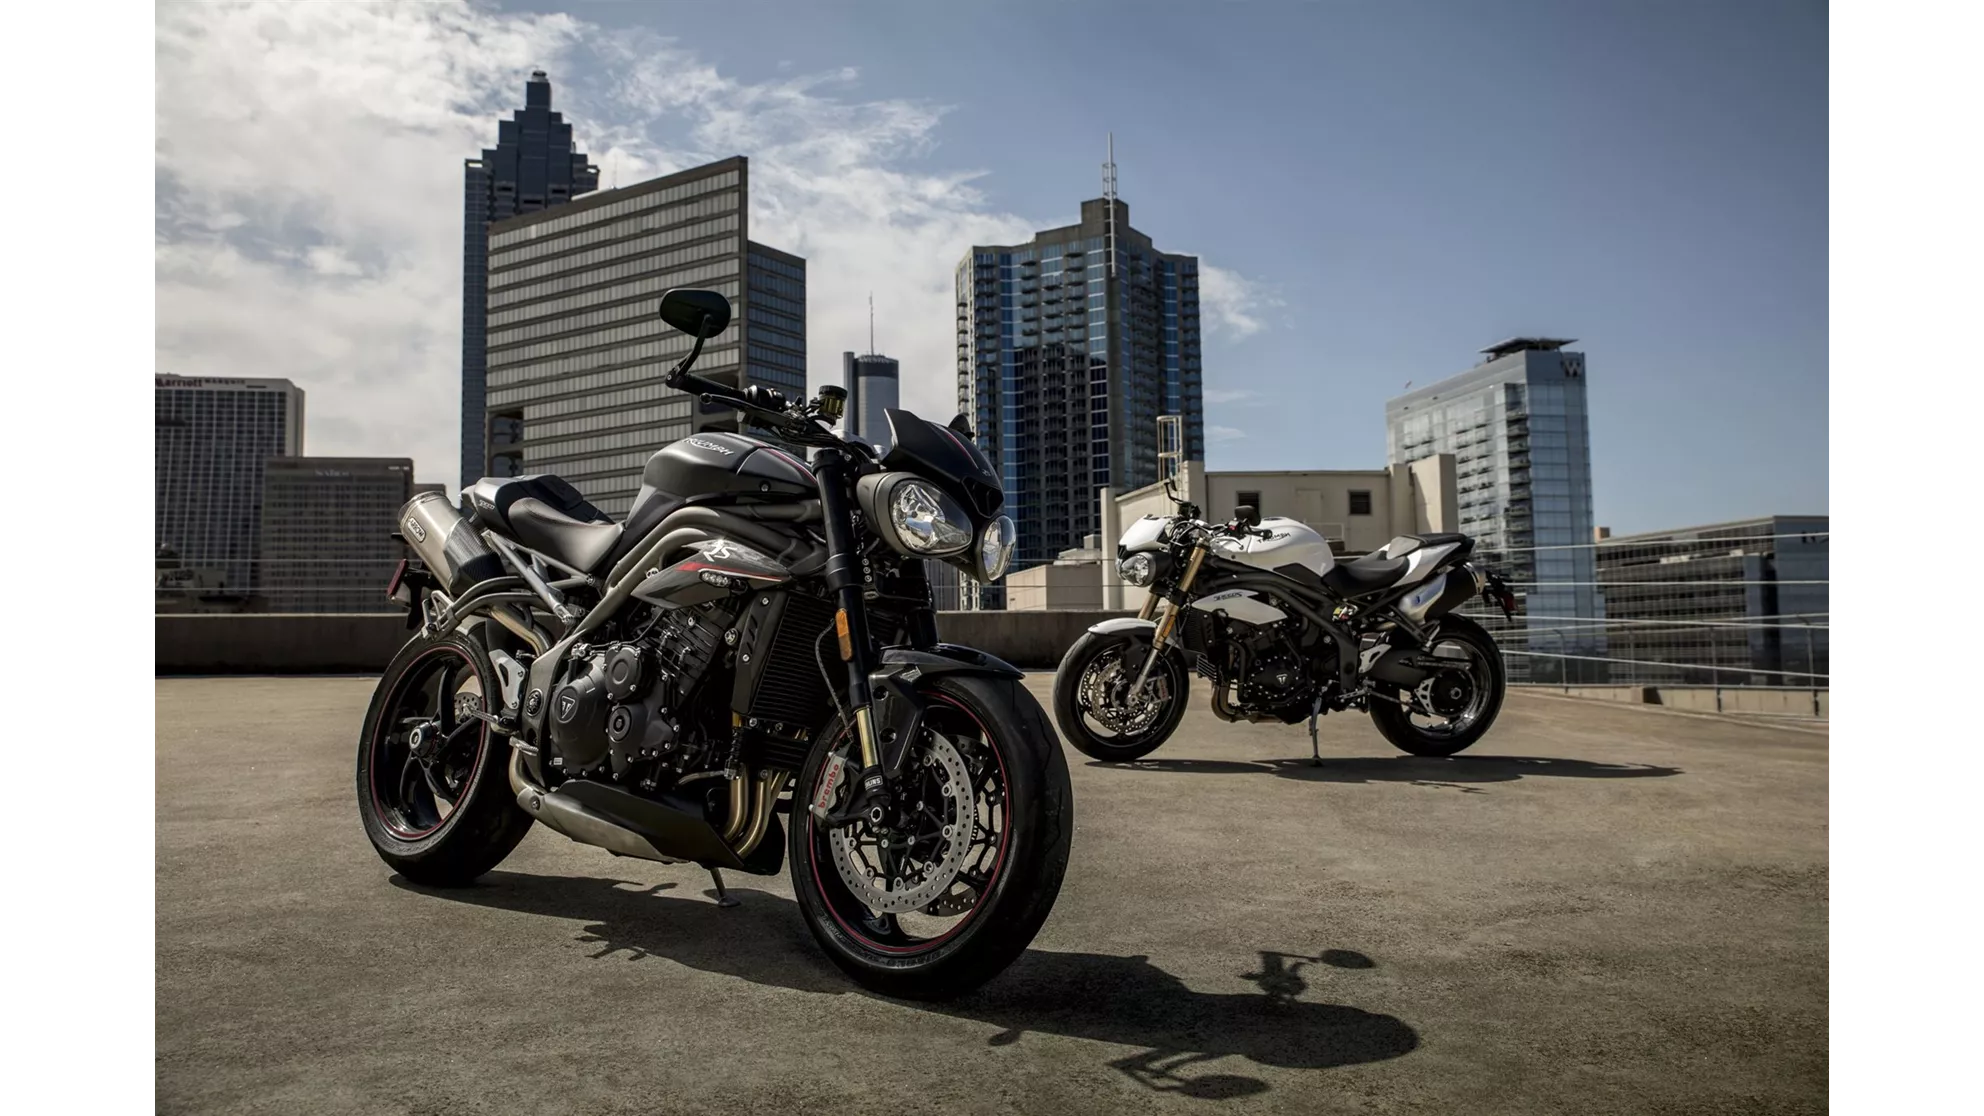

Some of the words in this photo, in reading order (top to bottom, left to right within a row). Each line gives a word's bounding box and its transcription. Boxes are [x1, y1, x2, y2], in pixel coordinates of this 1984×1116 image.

[1560, 359, 1583, 378] W
[682, 438, 734, 455] TRIUMPH
[703, 538, 738, 563] RS
[818, 764, 840, 808] brembo
